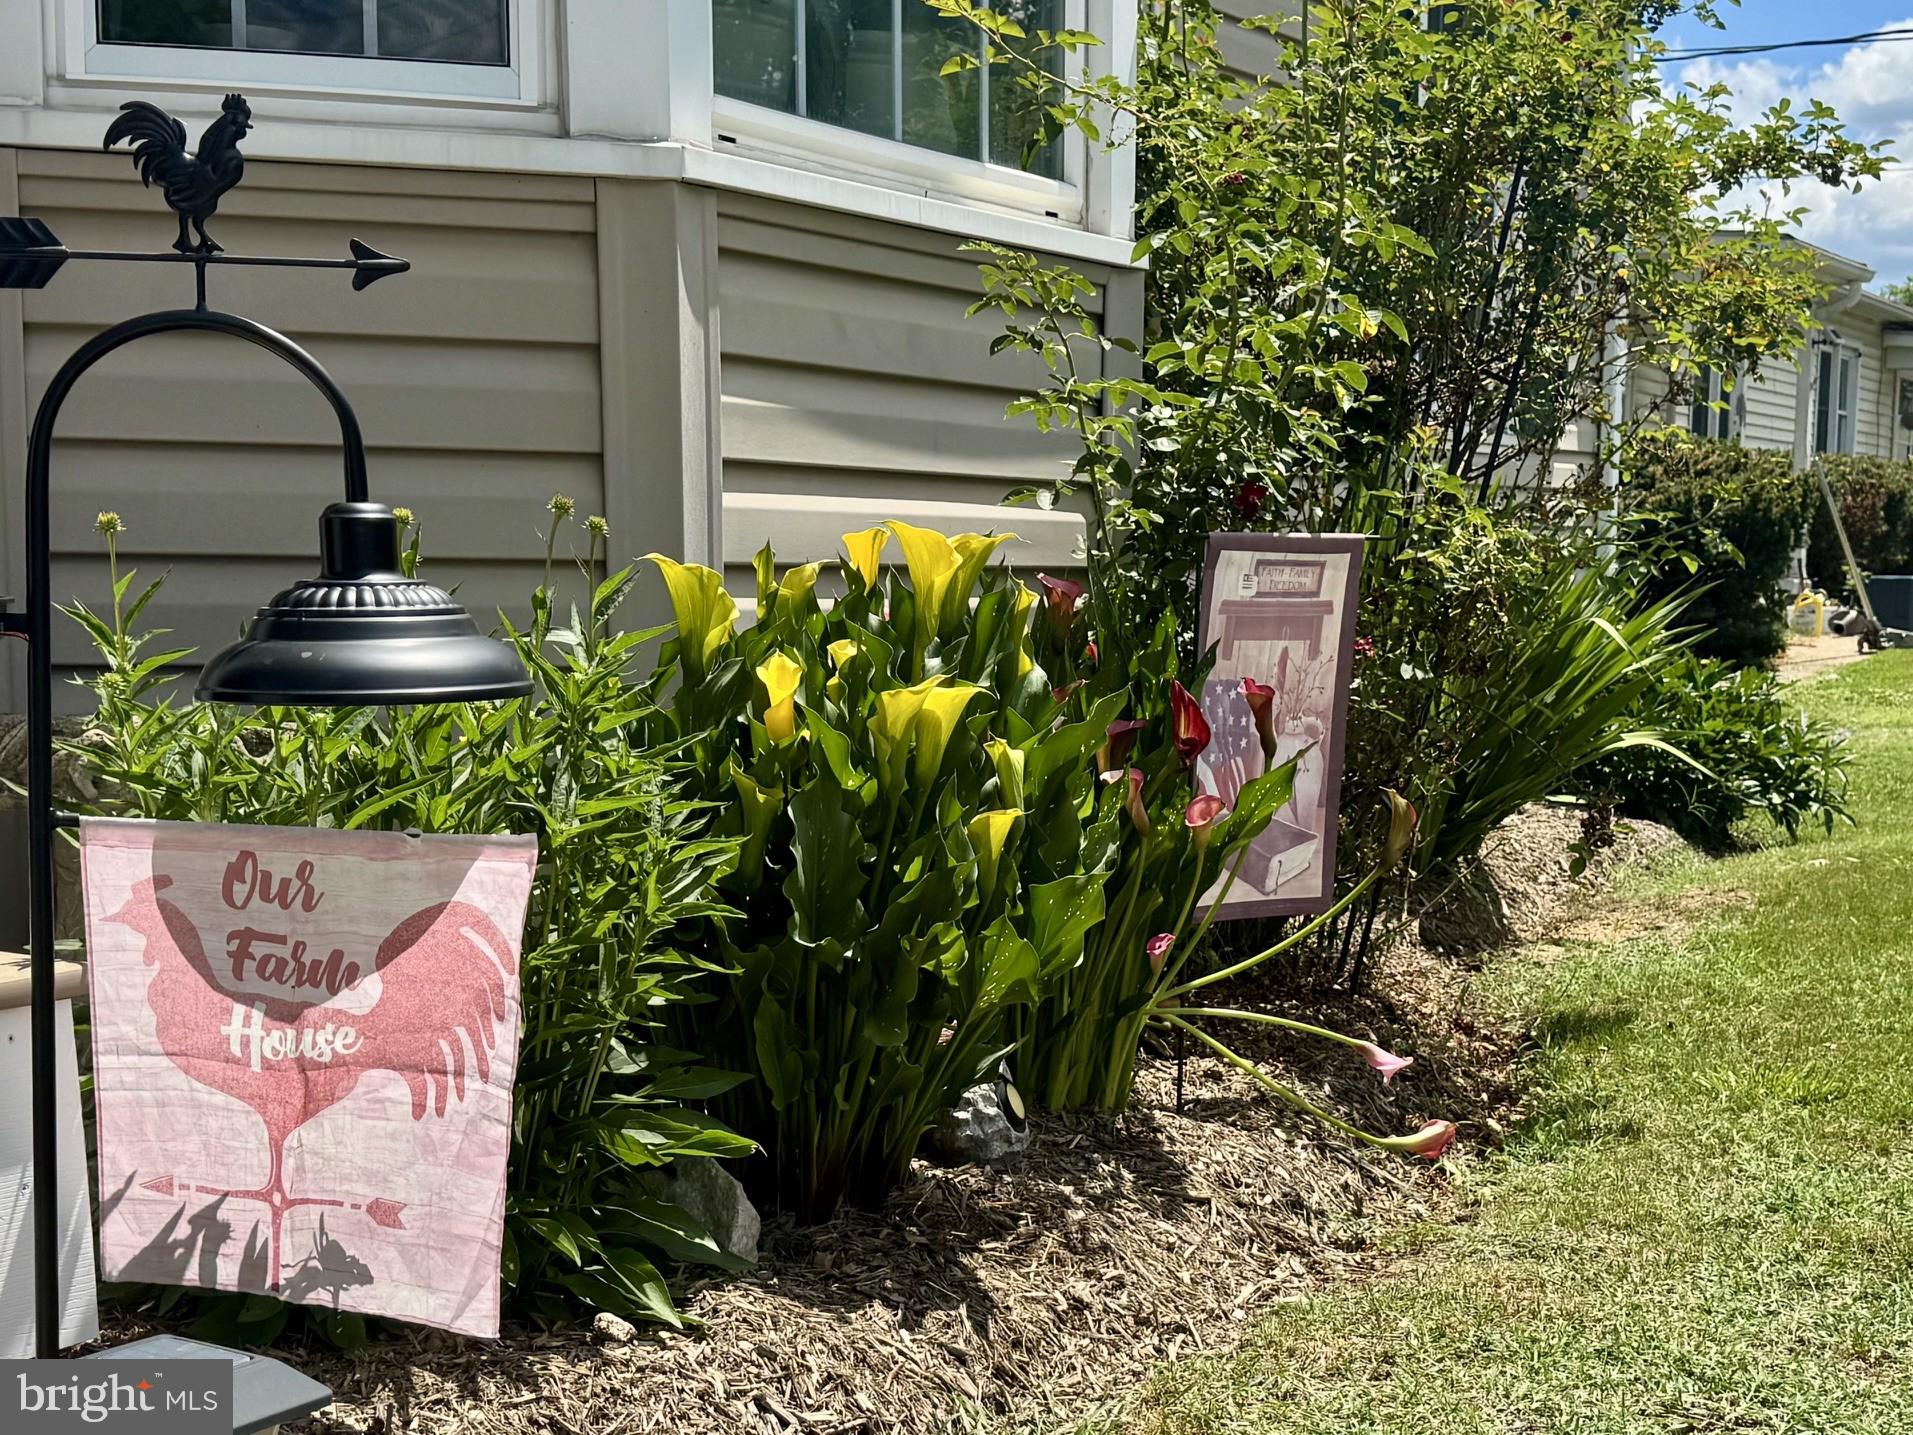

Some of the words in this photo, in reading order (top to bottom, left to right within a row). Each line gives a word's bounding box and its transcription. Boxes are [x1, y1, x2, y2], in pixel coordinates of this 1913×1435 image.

[1288, 567, 1316, 578] FAMILY
[222, 850, 325, 912] Our
[226, 926, 366, 996] Farm
[220, 1000, 364, 1072] House
